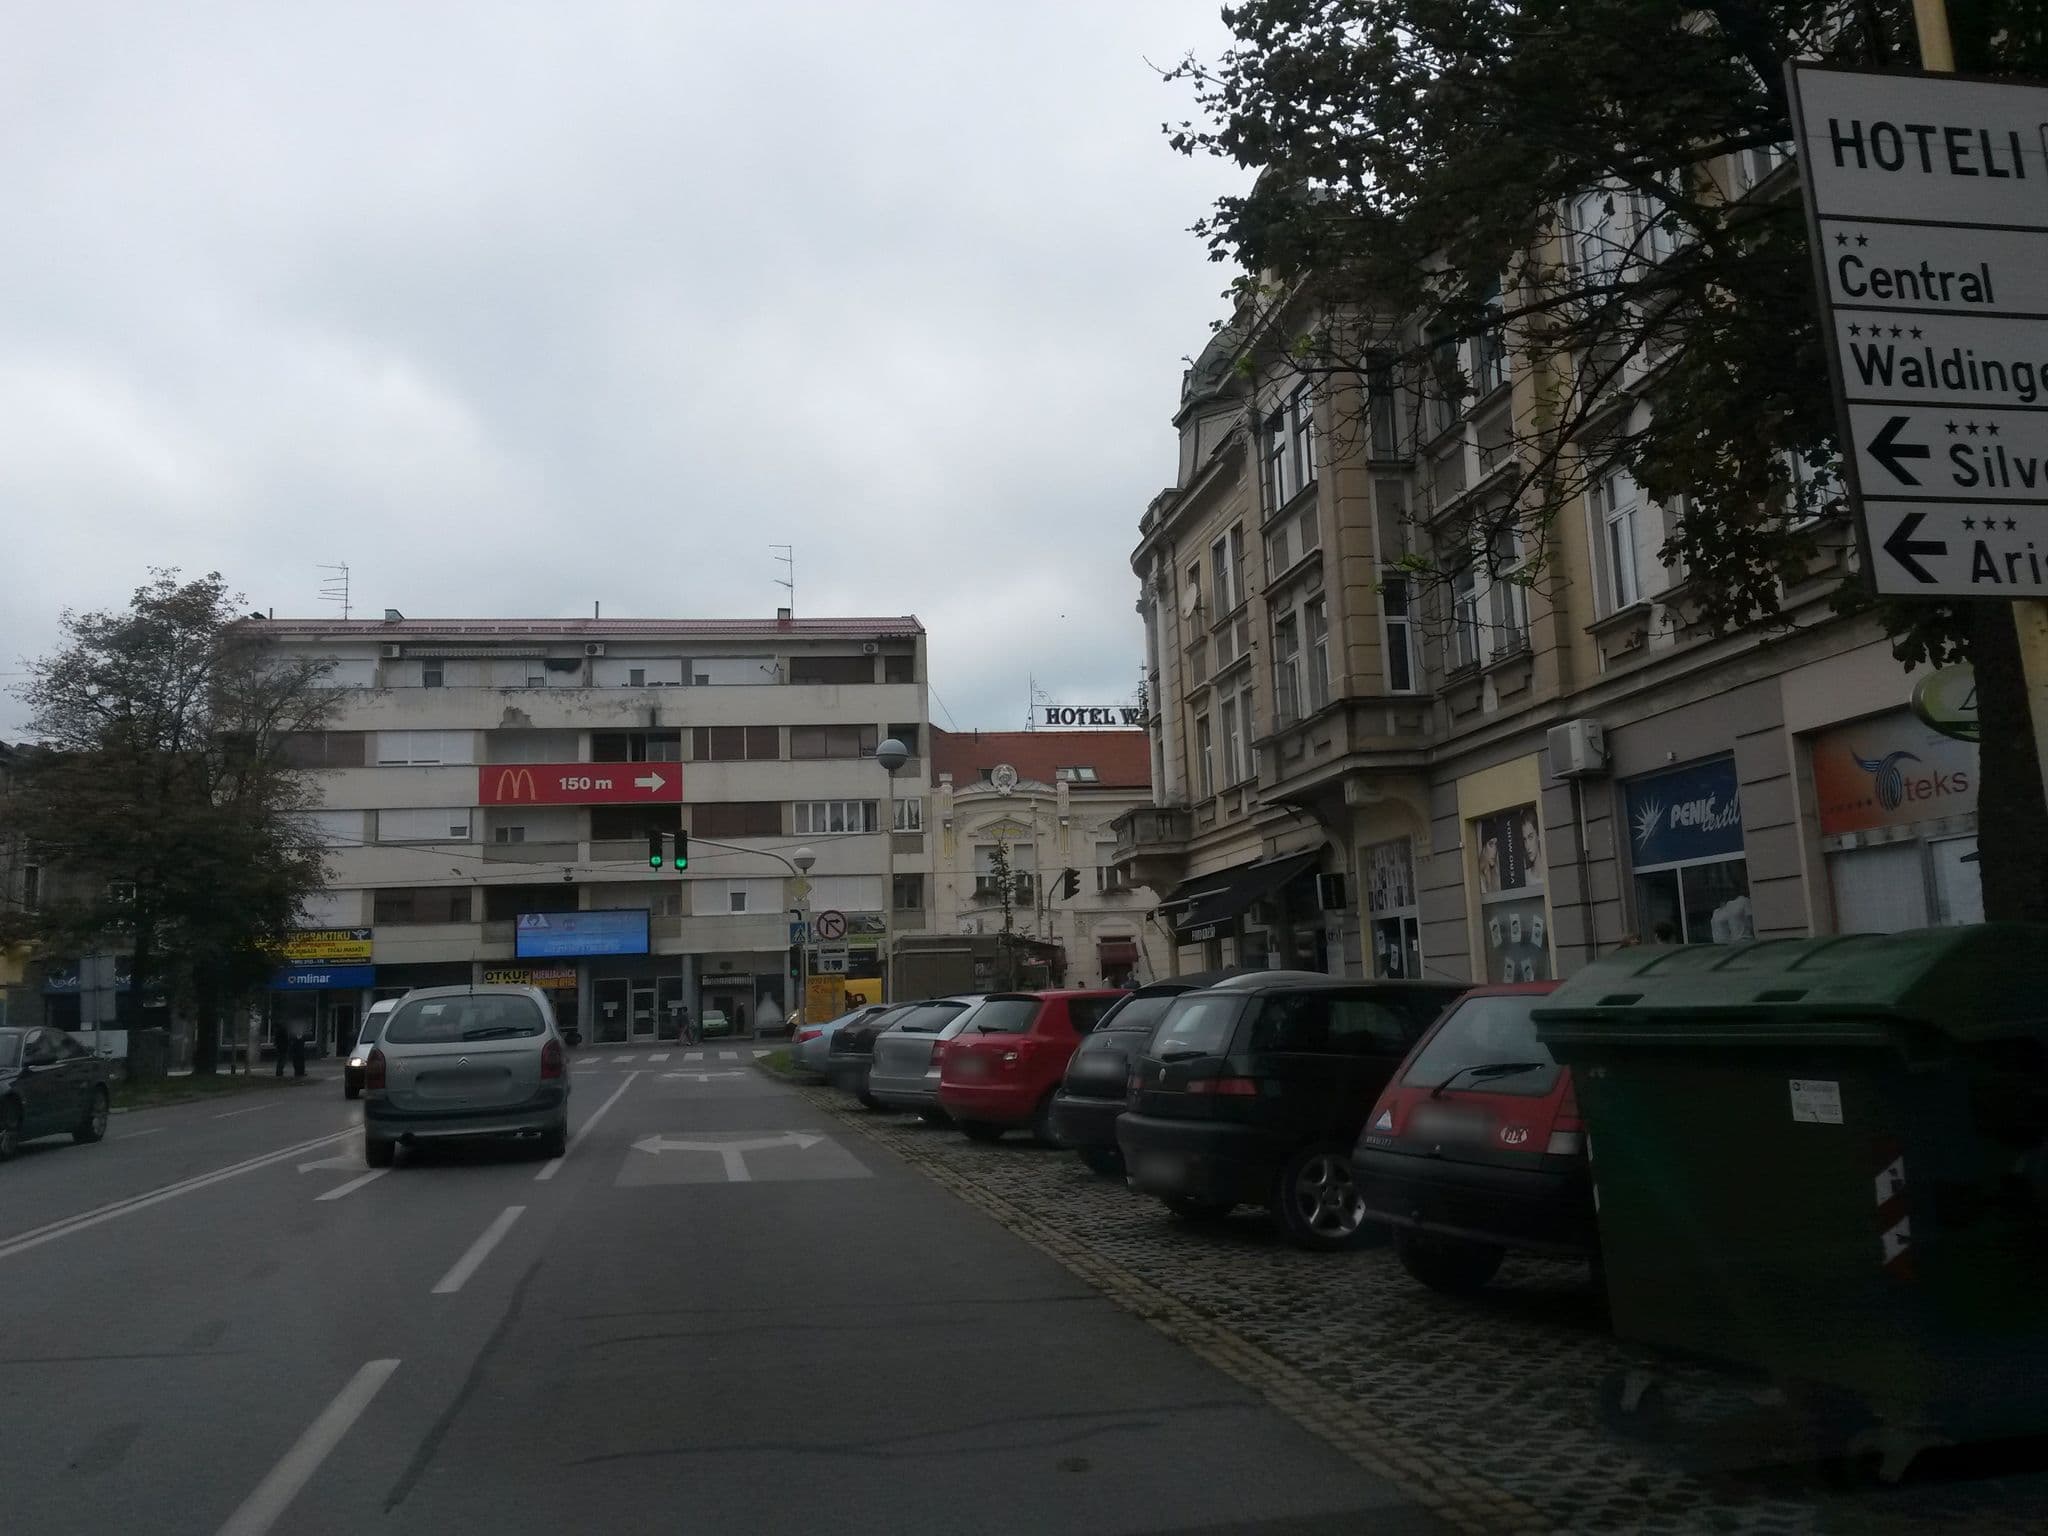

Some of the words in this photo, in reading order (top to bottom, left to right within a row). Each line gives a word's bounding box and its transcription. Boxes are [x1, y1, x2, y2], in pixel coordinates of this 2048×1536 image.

[1829, 118, 2026, 180] HOTELI
[1838, 254, 1995, 303] Central
[1948, 443, 2048, 489] Silv
[1971, 540, 2048, 585] Ari
[1045, 708, 1116, 725] HOTEL
[559, 777, 590, 790] 150
[595, 778, 613, 790] m
[297, 973, 331, 984] mlinar
[485, 970, 529, 980] OTKUP
